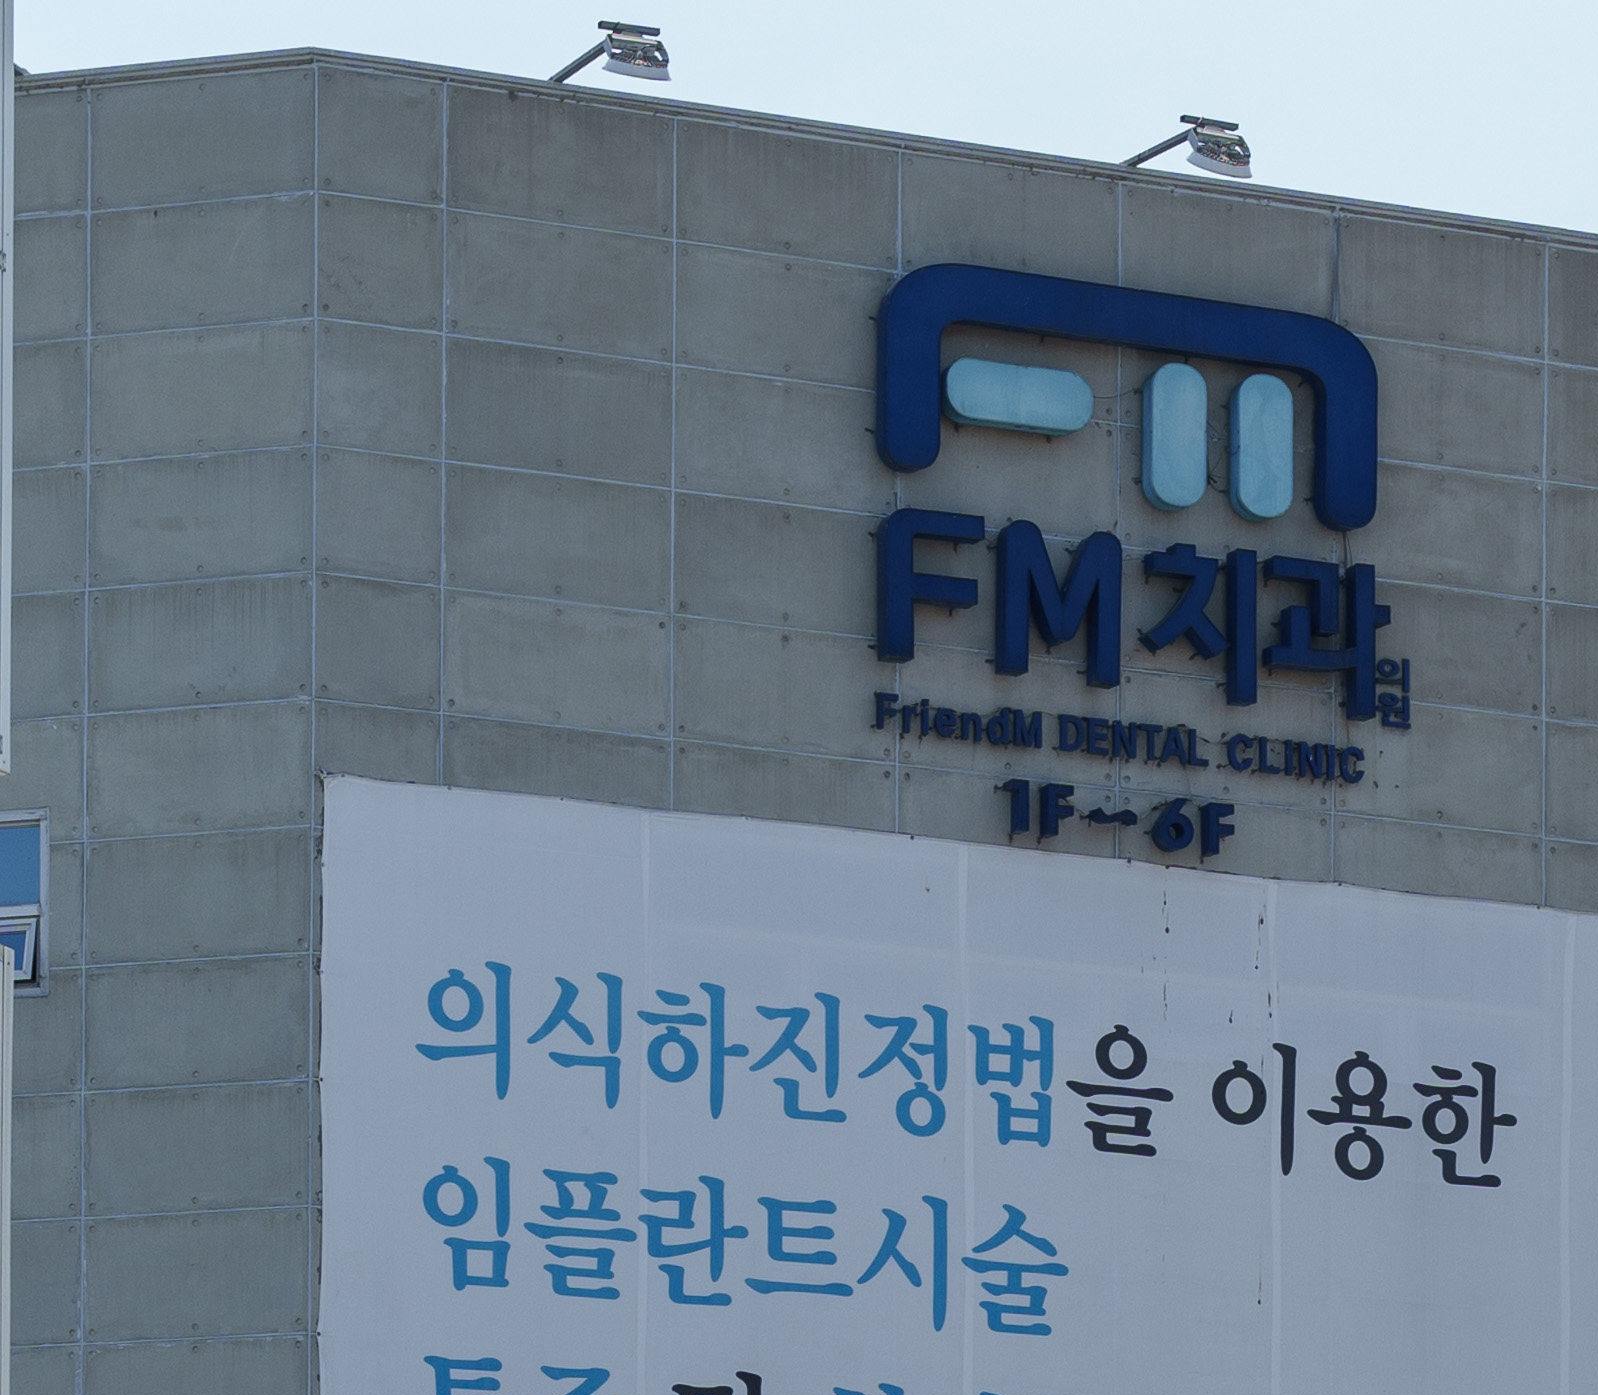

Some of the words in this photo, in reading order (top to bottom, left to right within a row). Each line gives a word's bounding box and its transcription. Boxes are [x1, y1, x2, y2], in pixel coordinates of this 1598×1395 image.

[877, 507, 1391, 722] FM치과
[1376, 656, 1411, 731] 의원
[874, 692, 1042, 750] FriendM
[1058, 713, 1209, 768] DENTAL
[1227, 732, 1366, 784] CLINIC
[415, 961, 1174, 1157] 의식하진정법을
[1211, 1042, 1518, 1188] 이용한
[422, 1156, 1069, 1337] 임플란트시술
